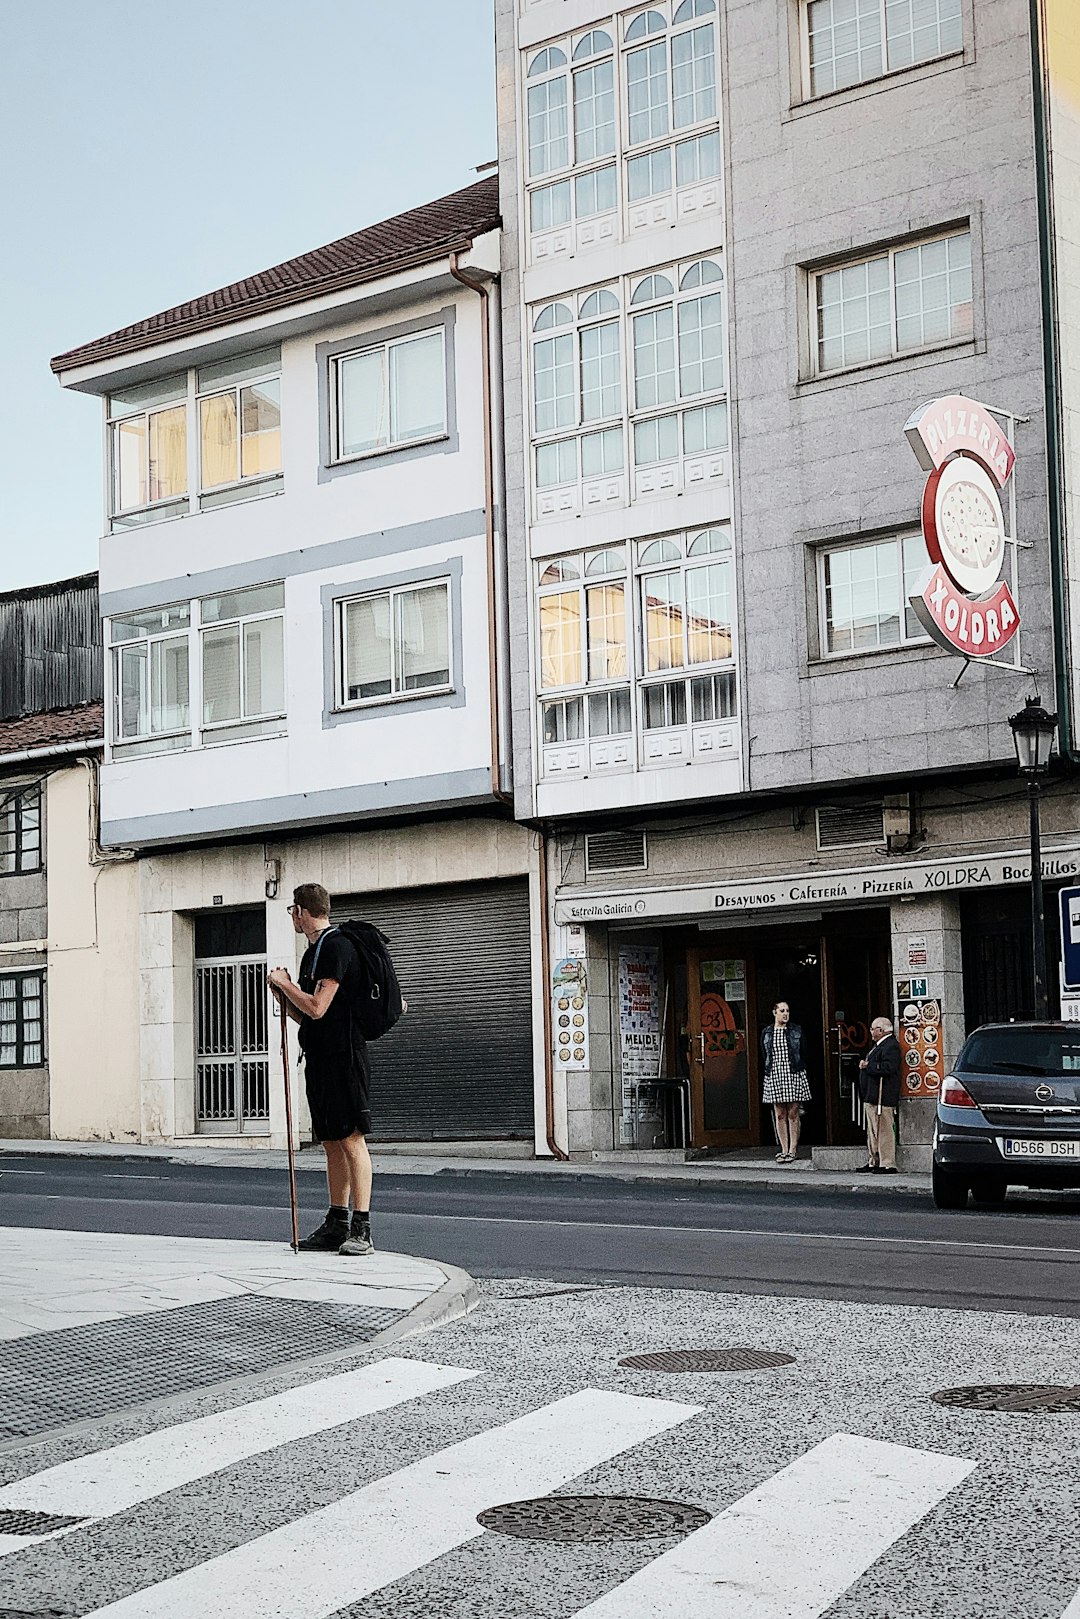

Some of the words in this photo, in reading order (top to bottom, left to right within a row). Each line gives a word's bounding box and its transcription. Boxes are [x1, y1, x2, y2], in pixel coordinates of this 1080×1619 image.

[927, 408, 1009, 476] PIZZERIA
[930, 578, 1016, 644] XOLDRA
[924, 866, 992, 888] XOLDRA
[571, 906, 603, 917] Estrella
[603, 903, 632, 915] Galicia
[915, 979, 923, 989] R
[625, 1034, 657, 1045] MELIDE
[1013, 1141, 1045, 1154] 0566
[1050, 1142, 1075, 1155] DSH
